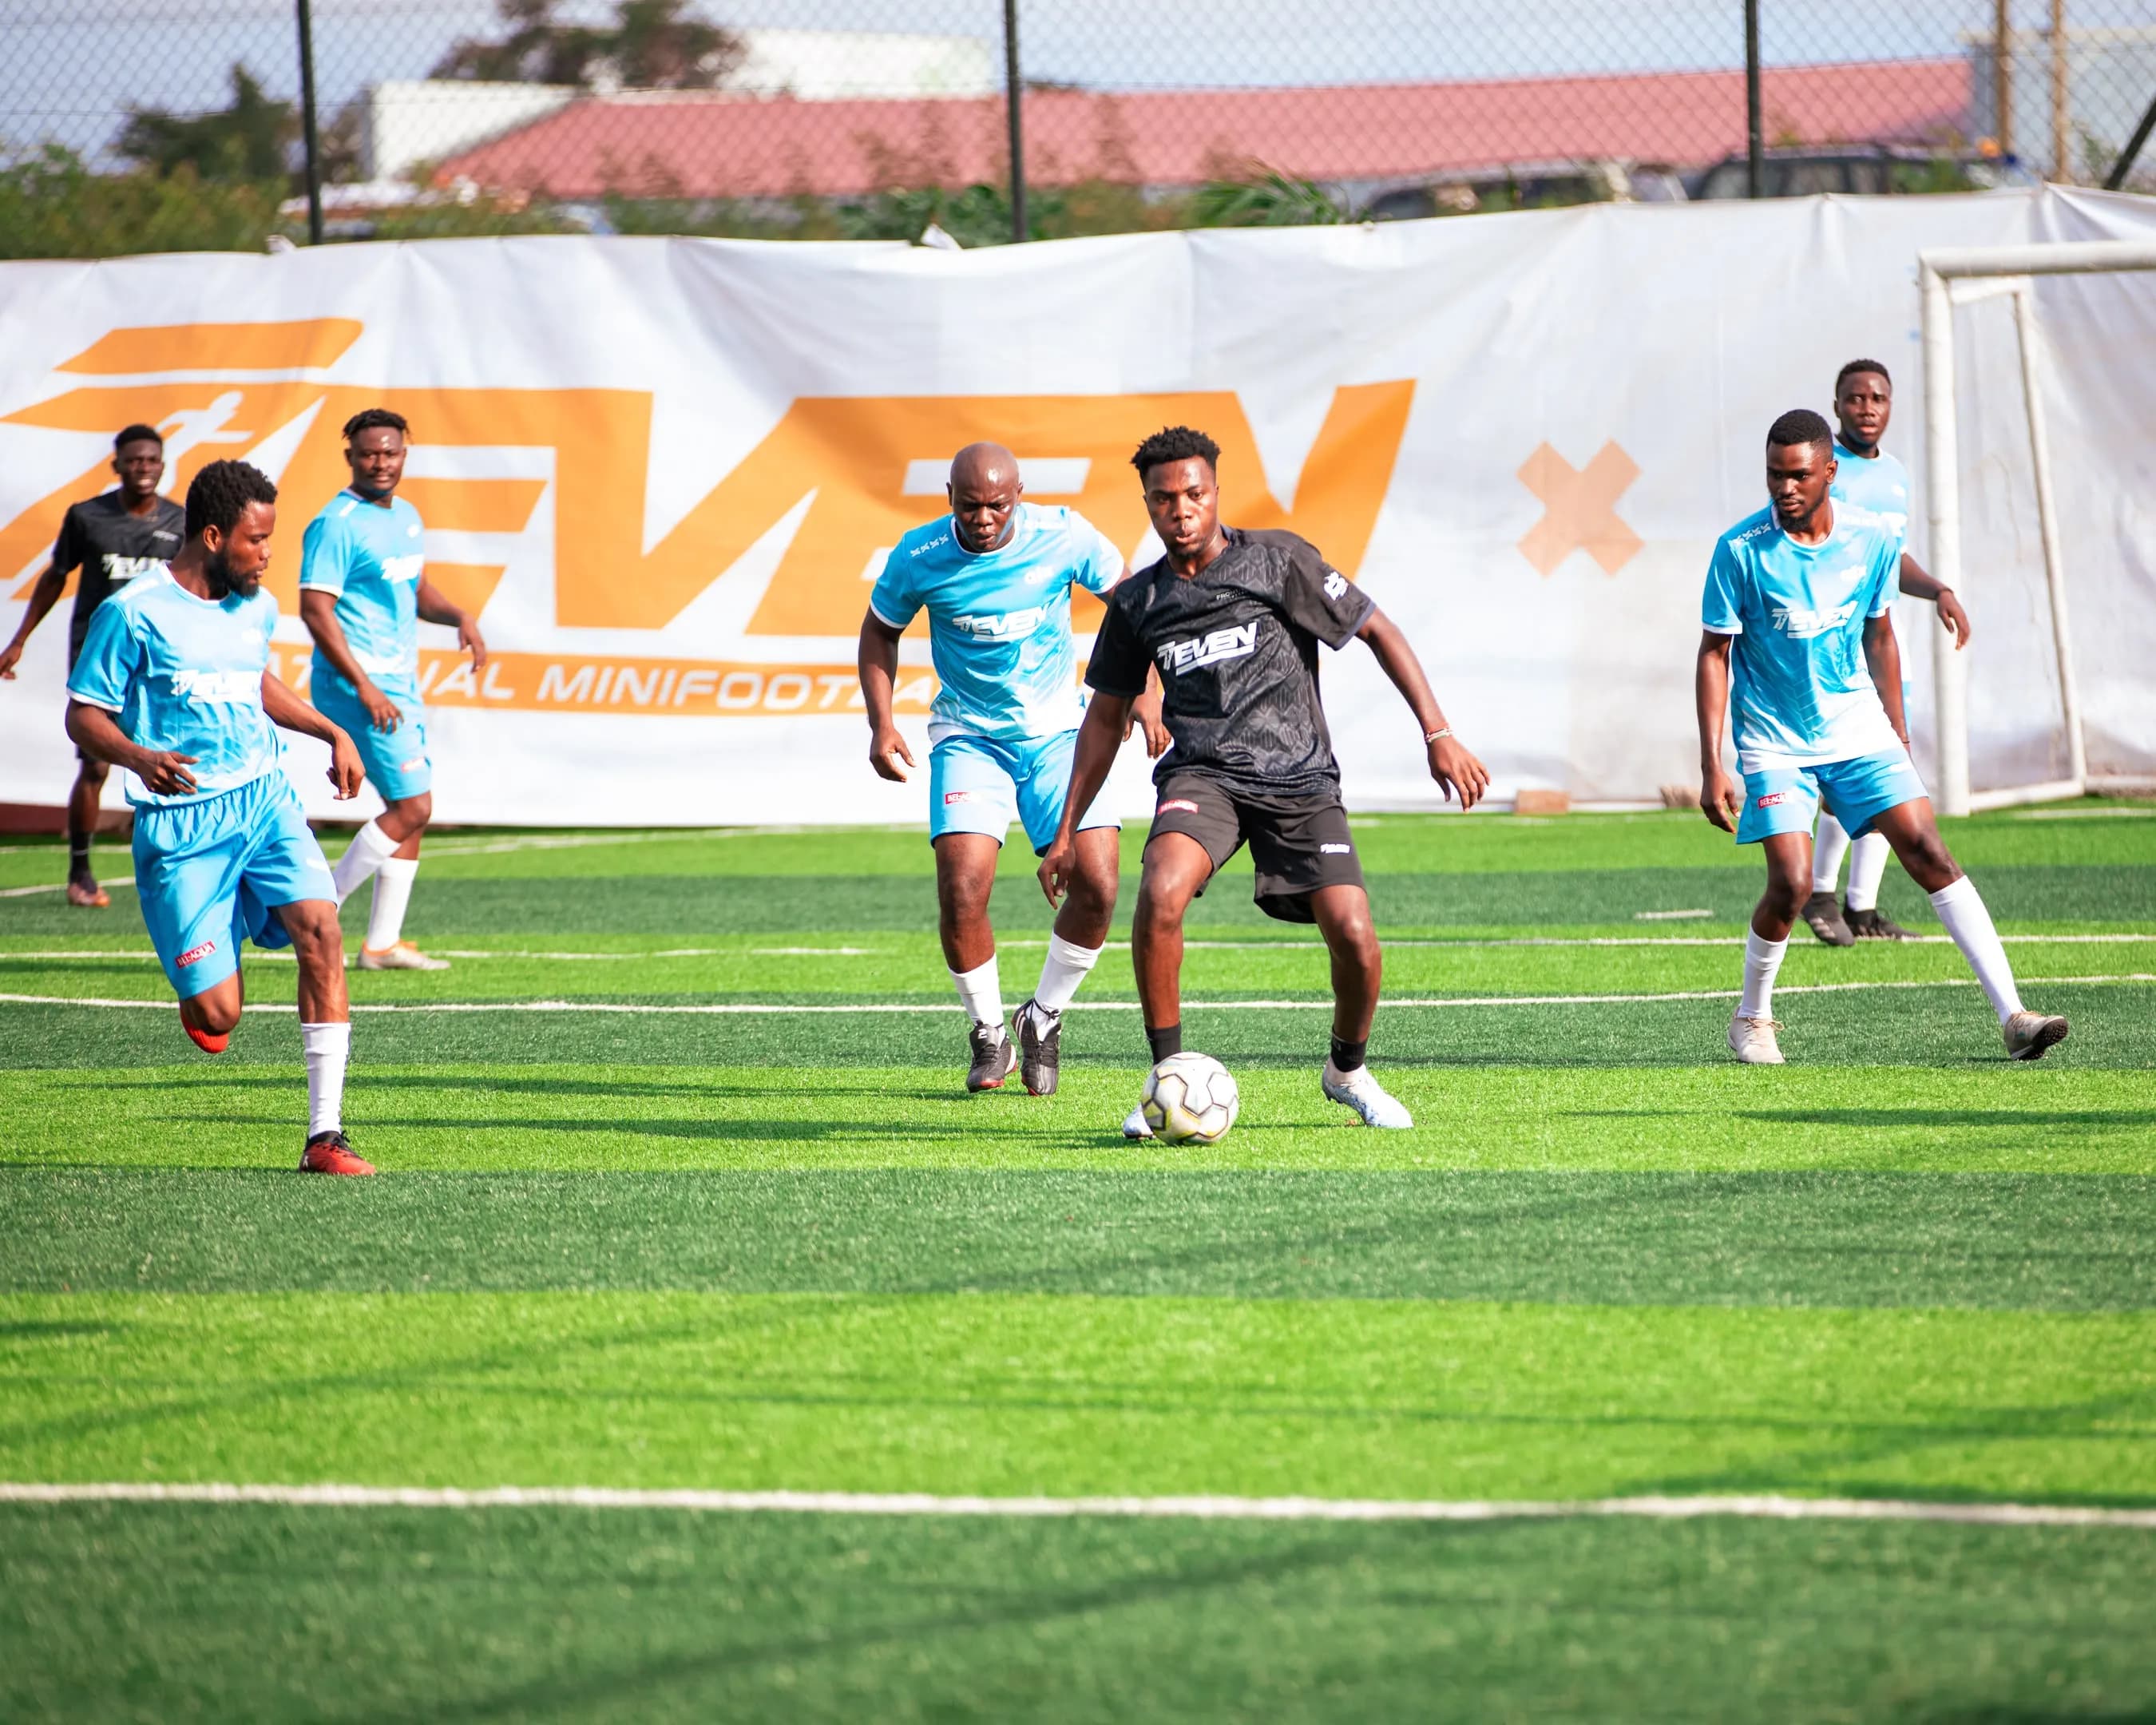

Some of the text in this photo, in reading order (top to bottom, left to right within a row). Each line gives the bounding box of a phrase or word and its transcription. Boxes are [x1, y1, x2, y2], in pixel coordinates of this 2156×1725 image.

[101, 553, 172, 580] 7EV
[1157, 622, 1258, 676] 7EVEN
[537, 664, 933, 710] MINIFOOTA
